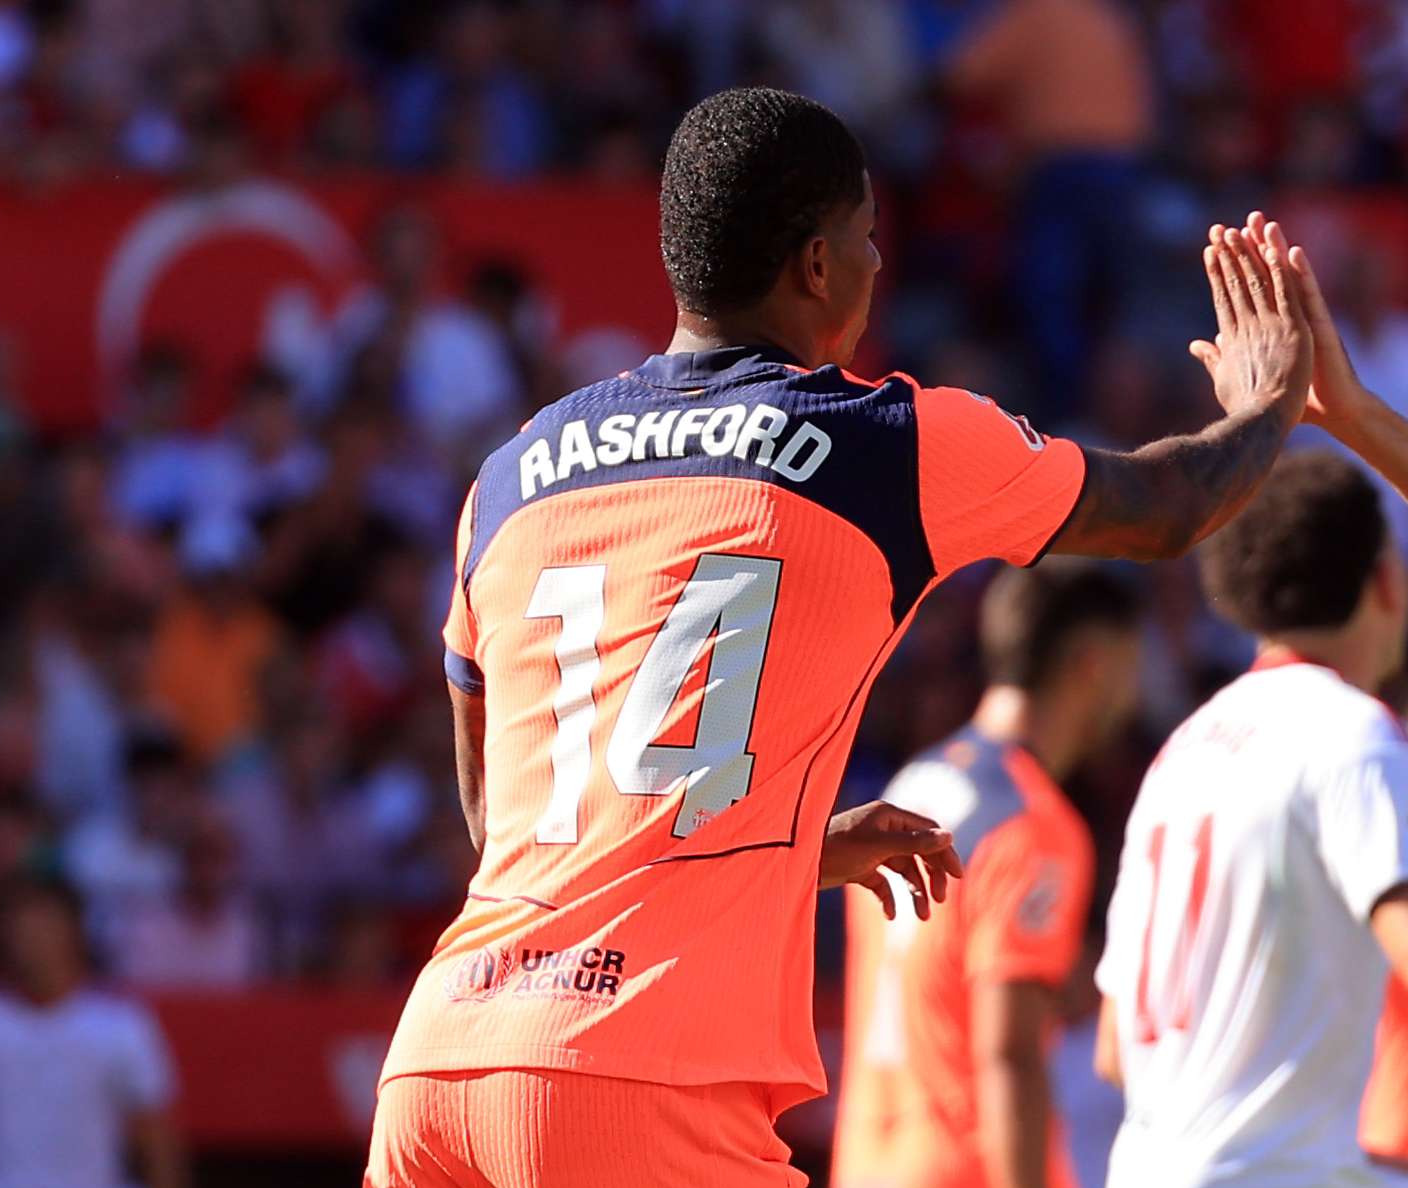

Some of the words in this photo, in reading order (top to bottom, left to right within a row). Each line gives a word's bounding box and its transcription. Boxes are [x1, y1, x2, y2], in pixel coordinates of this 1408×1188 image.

[519, 403, 832, 500] RASHFORD
[524, 553, 784, 845] 14
[514, 969, 620, 996] ACNUR
[521, 946, 626, 974] UNHCR
